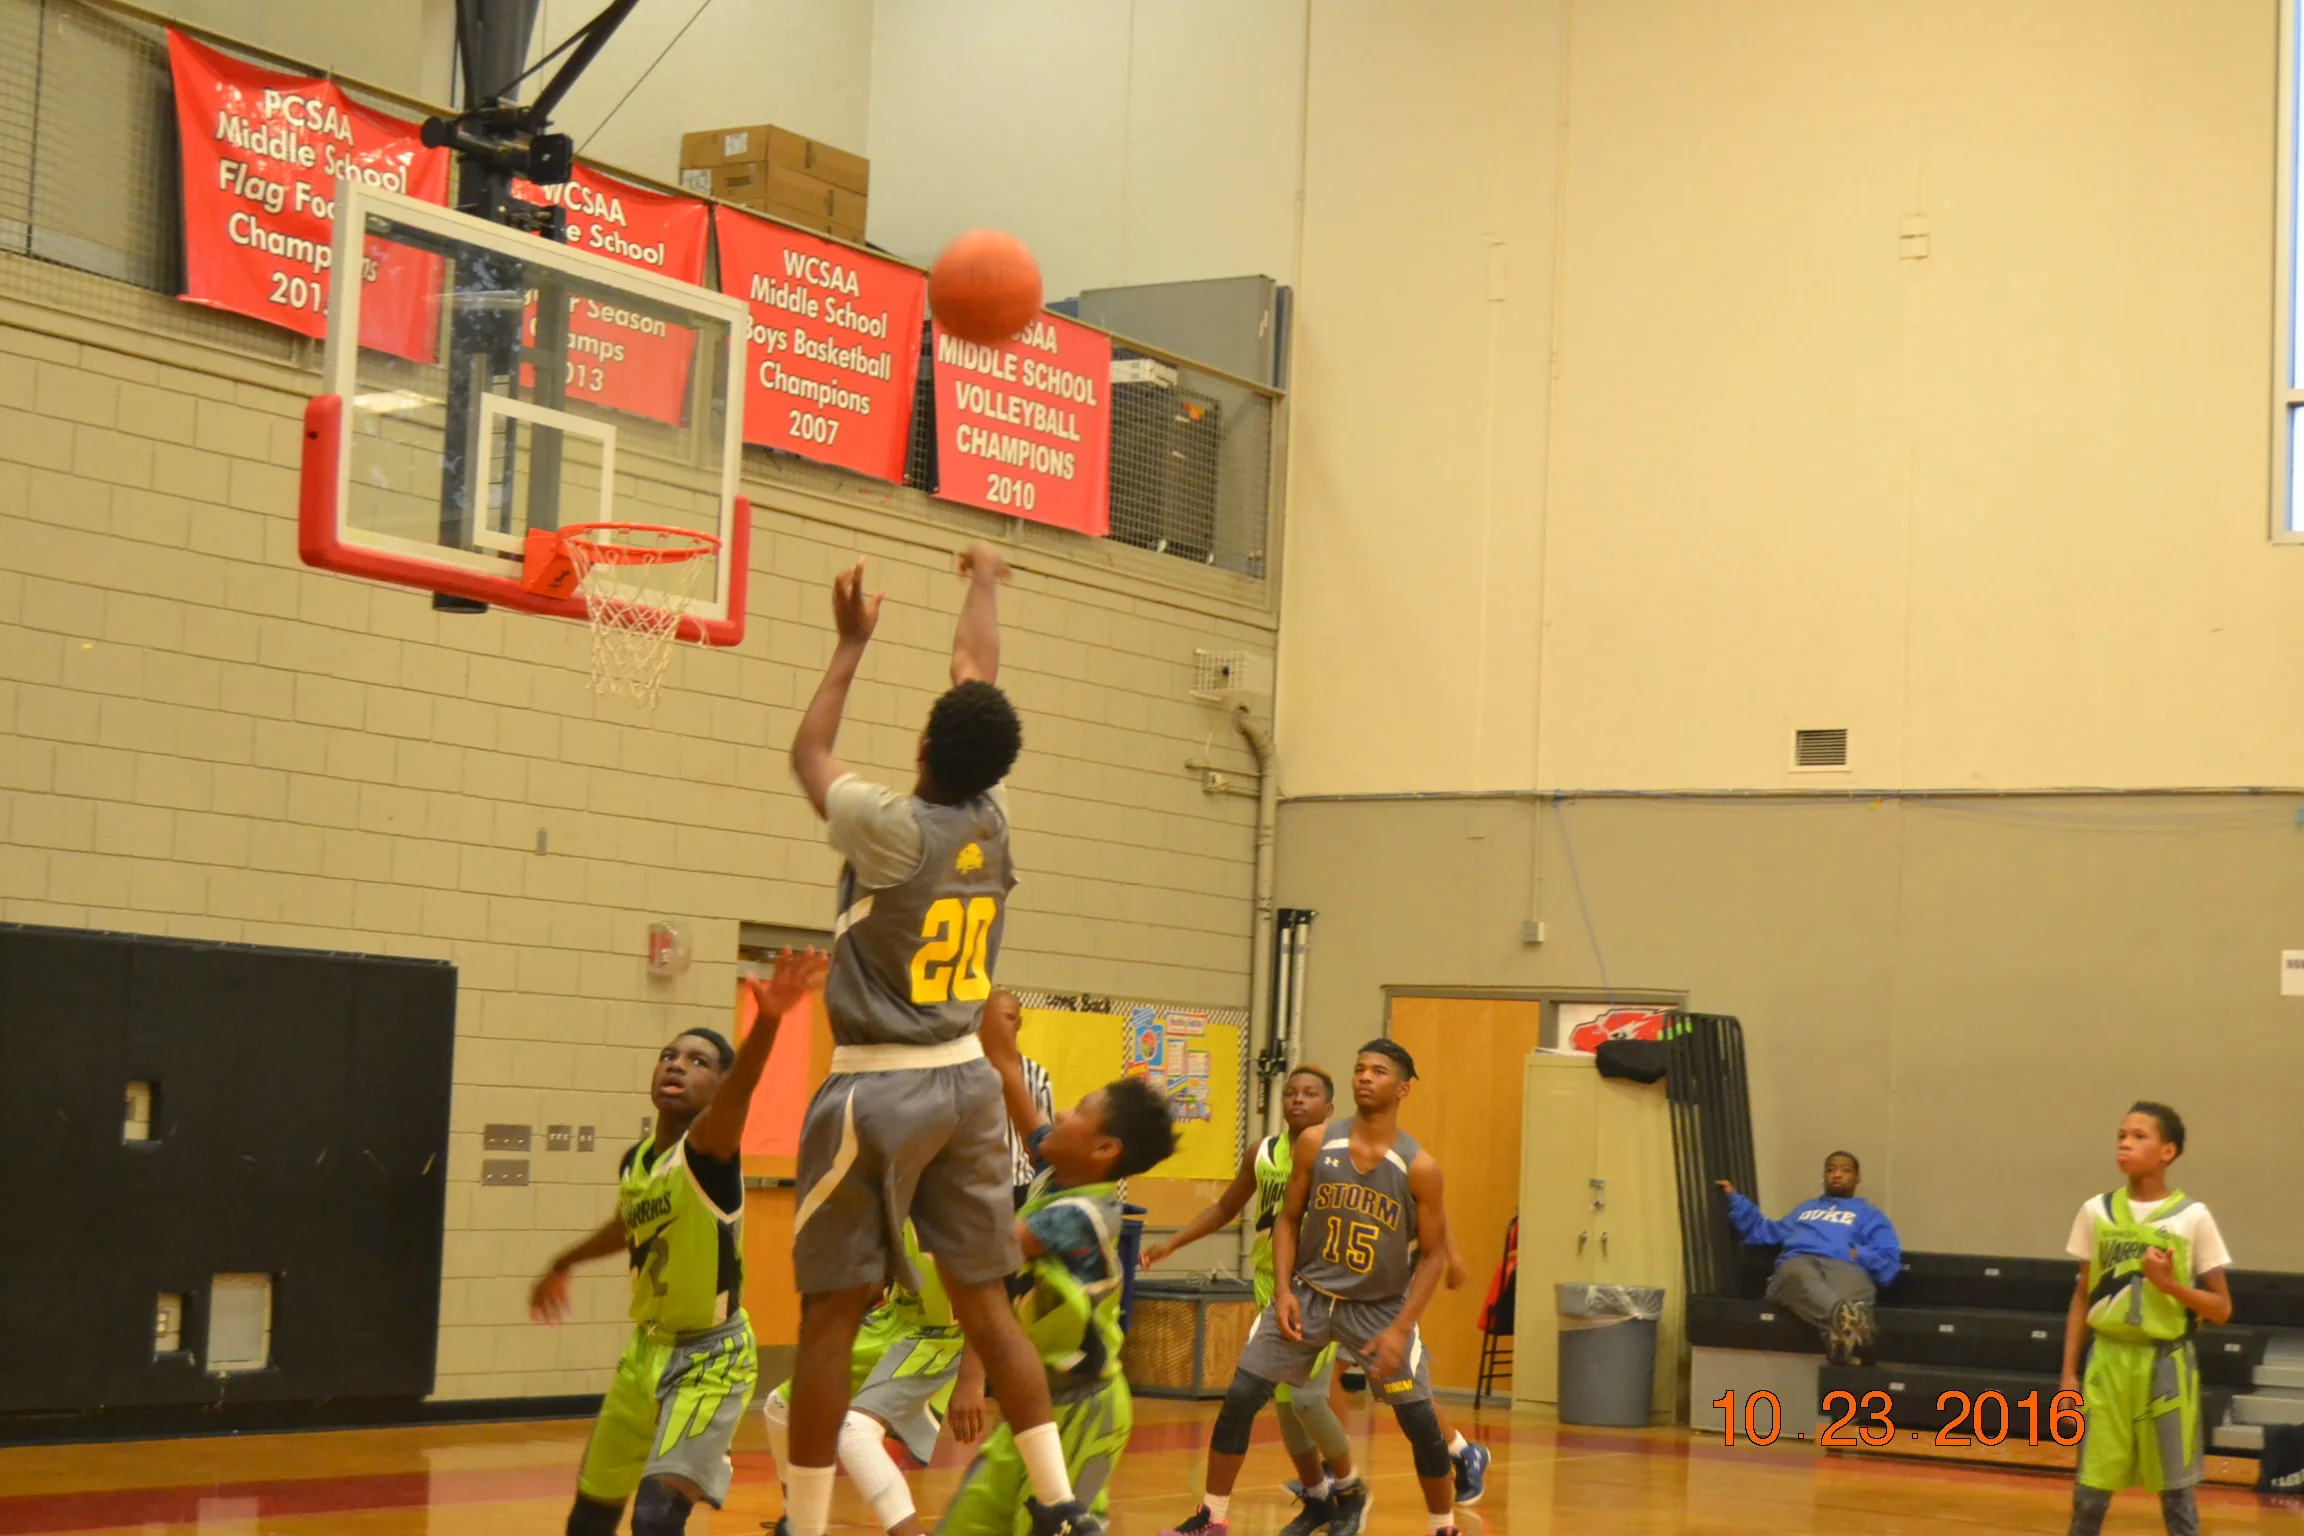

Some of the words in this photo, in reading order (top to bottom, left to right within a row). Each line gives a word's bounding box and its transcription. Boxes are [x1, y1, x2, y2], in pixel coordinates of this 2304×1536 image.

[264, 88, 354, 145] PCSAA
[215, 111, 316, 168] Middle
[324, 144, 408, 195] School
[218, 159, 285, 214] Flag
[589, 224, 666, 267] School
[269, 271, 329, 316] 201
[783, 249, 860, 298] WCSAA
[587, 299, 667, 338] Season
[750, 273, 819, 319] Middle
[825, 297, 888, 340] School
[793, 330, 891, 381] Basketball
[937, 334, 1018, 383] MIDDLE
[1022, 359, 1098, 407] SCHOOL
[759, 361, 871, 417] Champions
[954, 380, 1081, 442] VOLLEYBALL
[788, 410, 840, 447] 2007
[955, 423, 1075, 481] CHAMPIONS
[986, 473, 1036, 512] 2010
[911, 897, 997, 1004] 20
[1315, 1182, 1401, 1230] STORM
[1797, 1208, 1857, 1225] DUKE
[1323, 1216, 1380, 1275] 15
